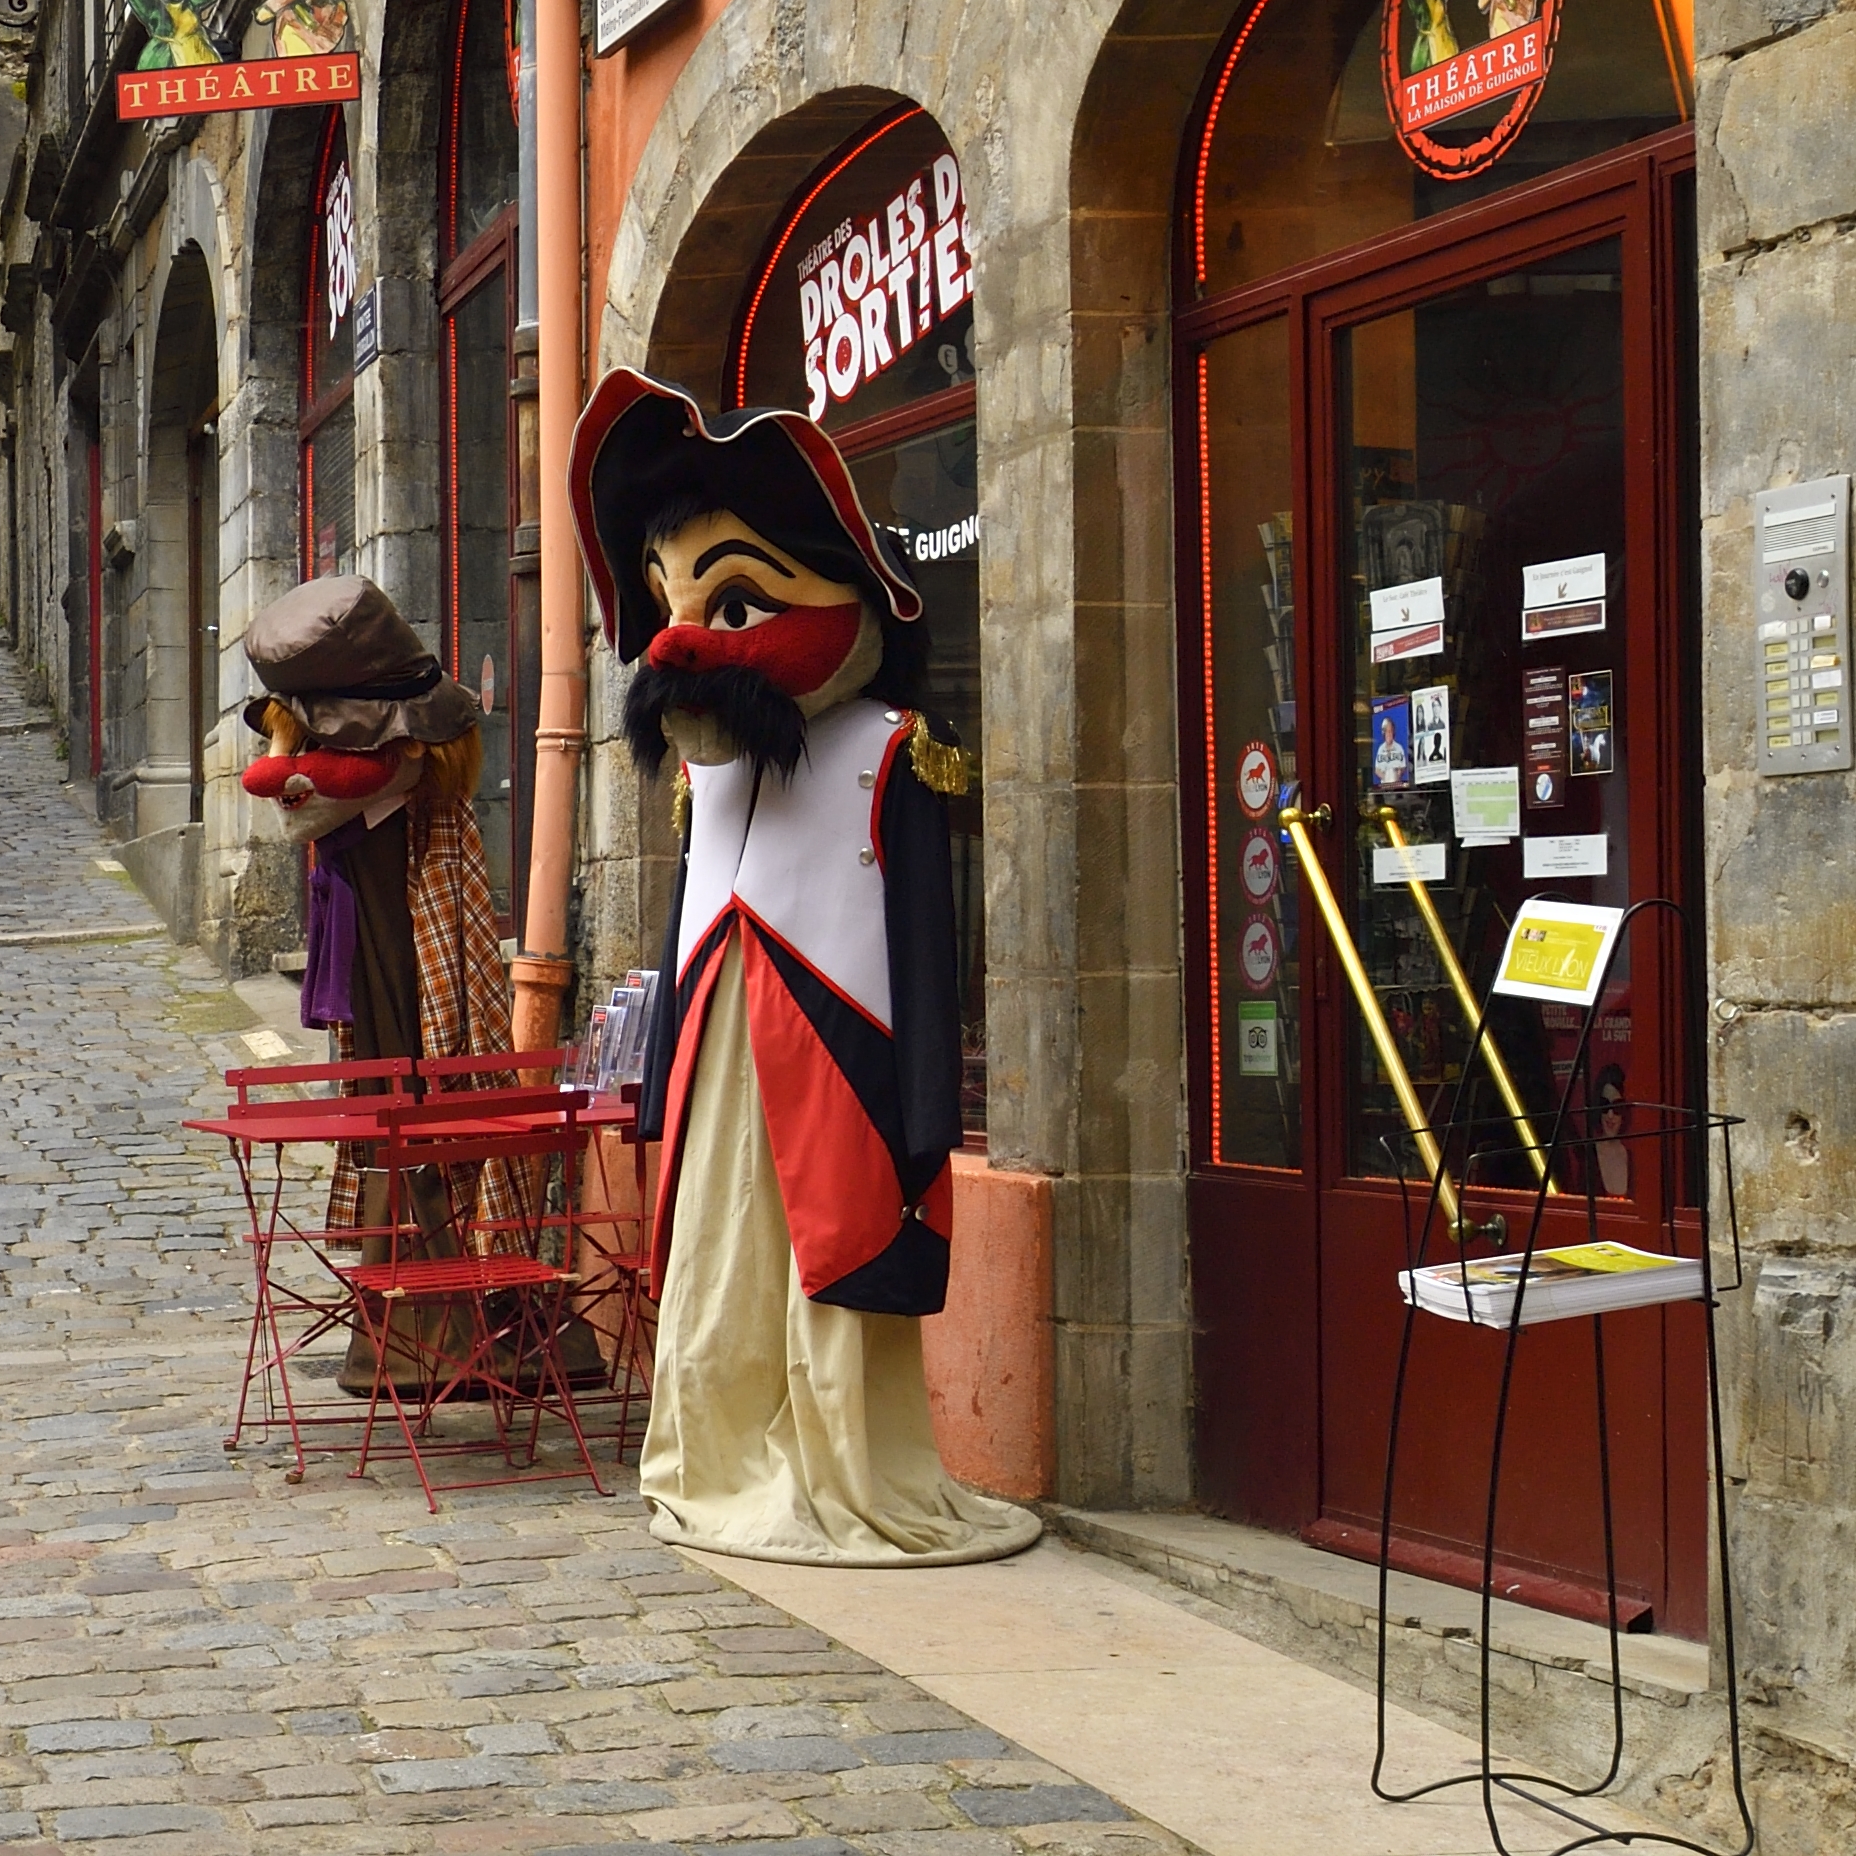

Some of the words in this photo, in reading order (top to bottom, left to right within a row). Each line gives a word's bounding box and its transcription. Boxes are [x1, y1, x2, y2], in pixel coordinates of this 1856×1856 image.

[123, 63, 354, 108] THÉÂTRE
[1406, 32, 1537, 108] THÉÂTRE
[1407, 108, 1422, 124] LA
[1423, 87, 1466, 118] MAISON
[1468, 81, 1484, 99] DE
[1486, 60, 1538, 91] GUIGNOL
[932, 152, 967, 227] D
[796, 233, 834, 282] THÉÂTRE
[834, 216, 853, 249] DES
[1515, 951, 1552, 974] VIEUX
[1551, 949, 1589, 979] LYON
